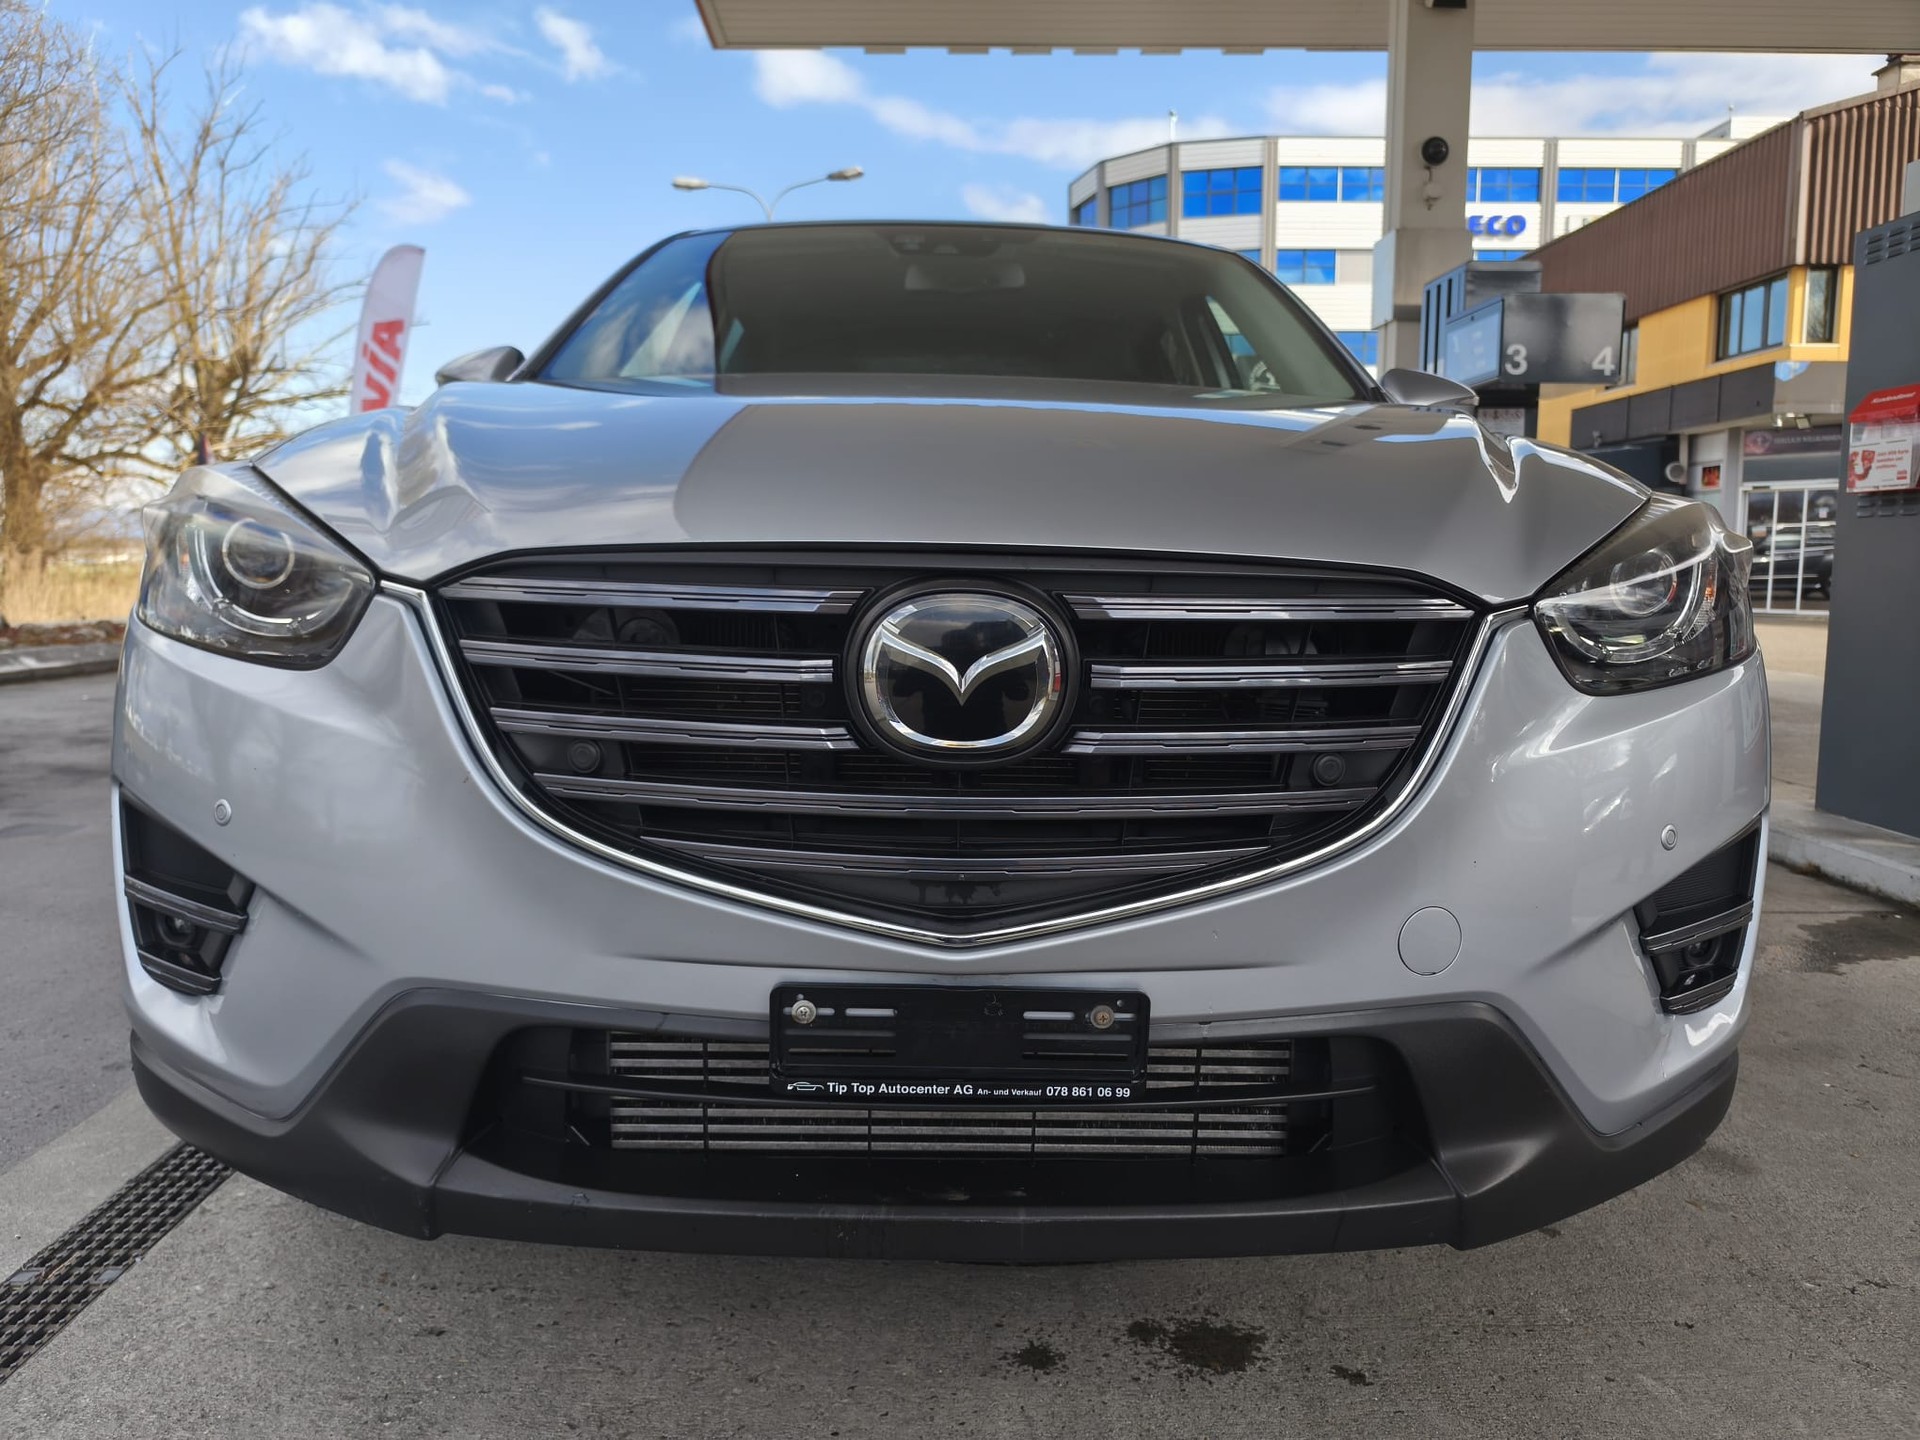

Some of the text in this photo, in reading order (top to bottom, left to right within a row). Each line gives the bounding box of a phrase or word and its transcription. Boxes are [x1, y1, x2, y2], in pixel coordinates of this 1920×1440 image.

[1504, 344, 1528, 375] 3
[1592, 346, 1615, 376] 4
[827, 1082, 847, 1095] Tip
[851, 1083, 875, 1095] Top
[878, 1083, 950, 1095] Autocenter
[953, 1084, 973, 1095] AG
[993, 1088, 1009, 1096] und
[1011, 1088, 1042, 1097] Verkauf
[1046, 1086, 1068, 1097] 078
[1071, 1086, 1093, 1097] 861
[1097, 1087, 1112, 1098] 06
[1115, 1087, 1131, 1098] 99
